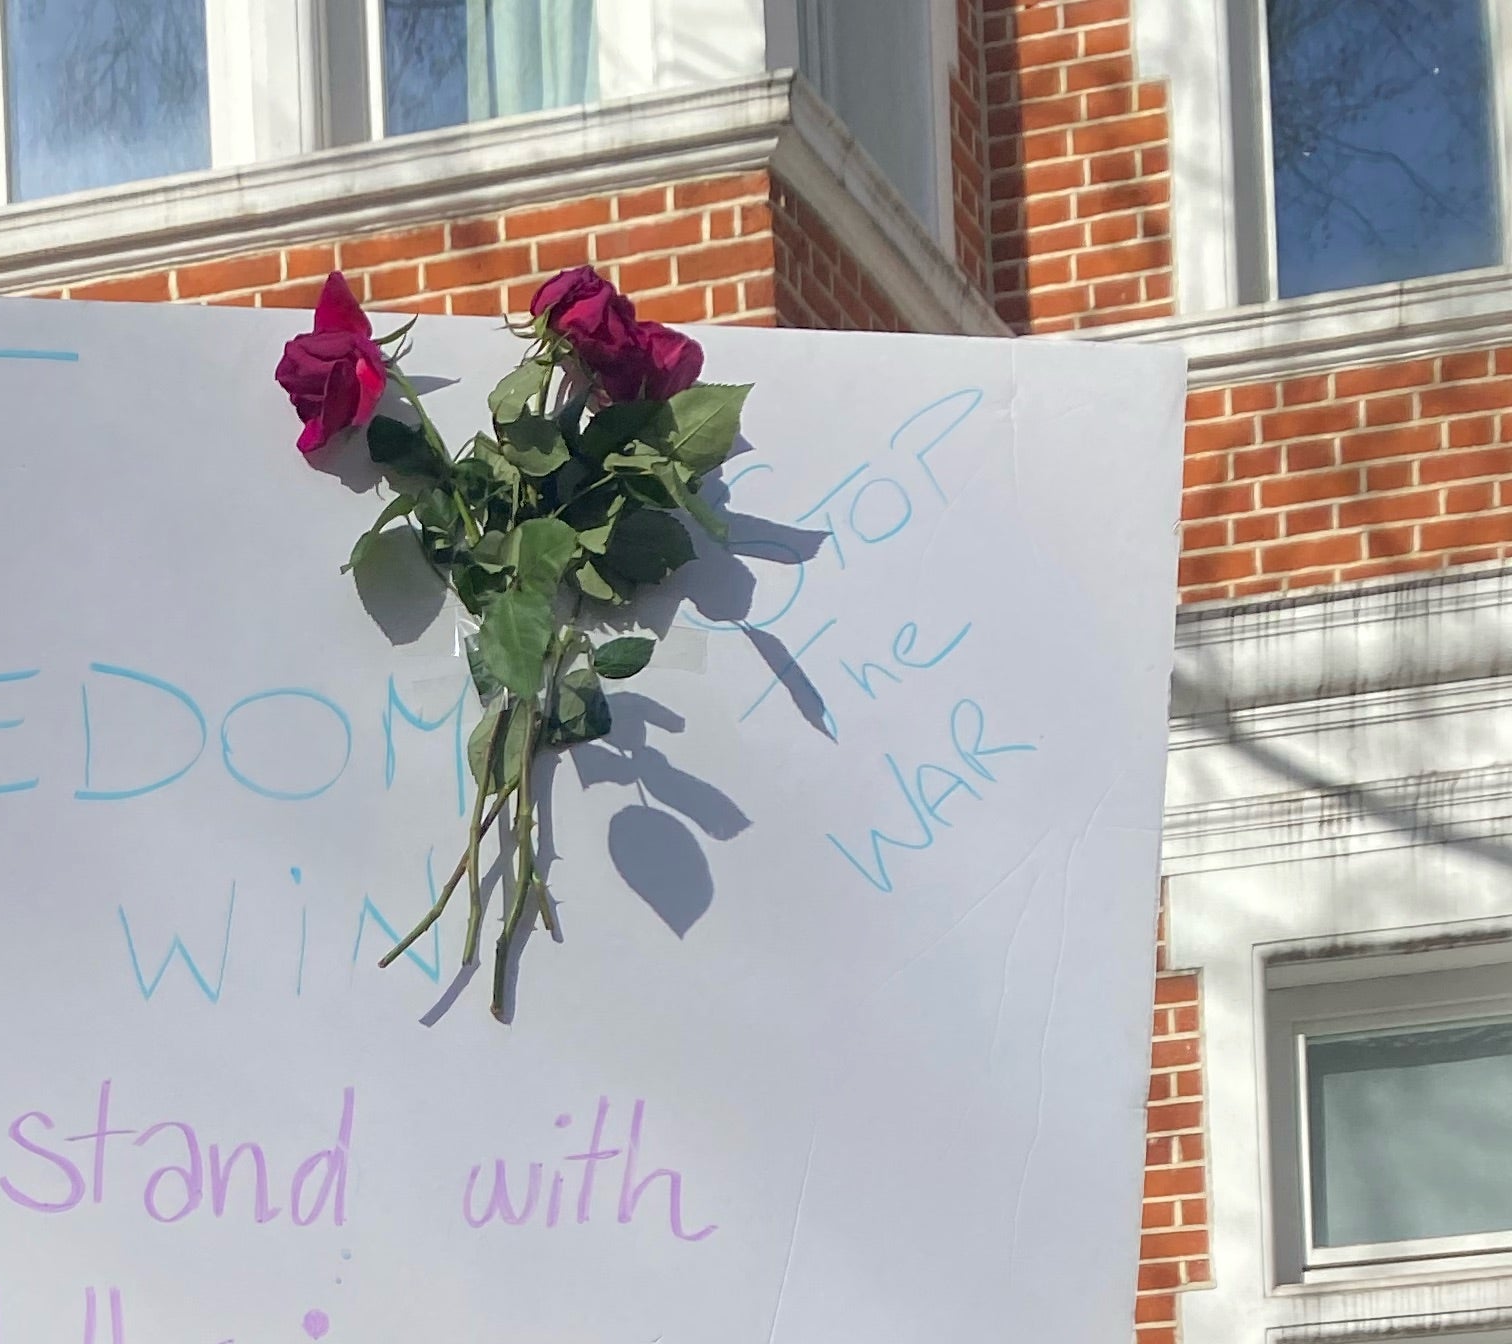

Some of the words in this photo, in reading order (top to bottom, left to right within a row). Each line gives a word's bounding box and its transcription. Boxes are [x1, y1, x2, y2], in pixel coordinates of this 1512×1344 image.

[684, 387, 984, 632] STOP
[826, 697, 1037, 893] WAR
[462, 1095, 719, 1242] with
